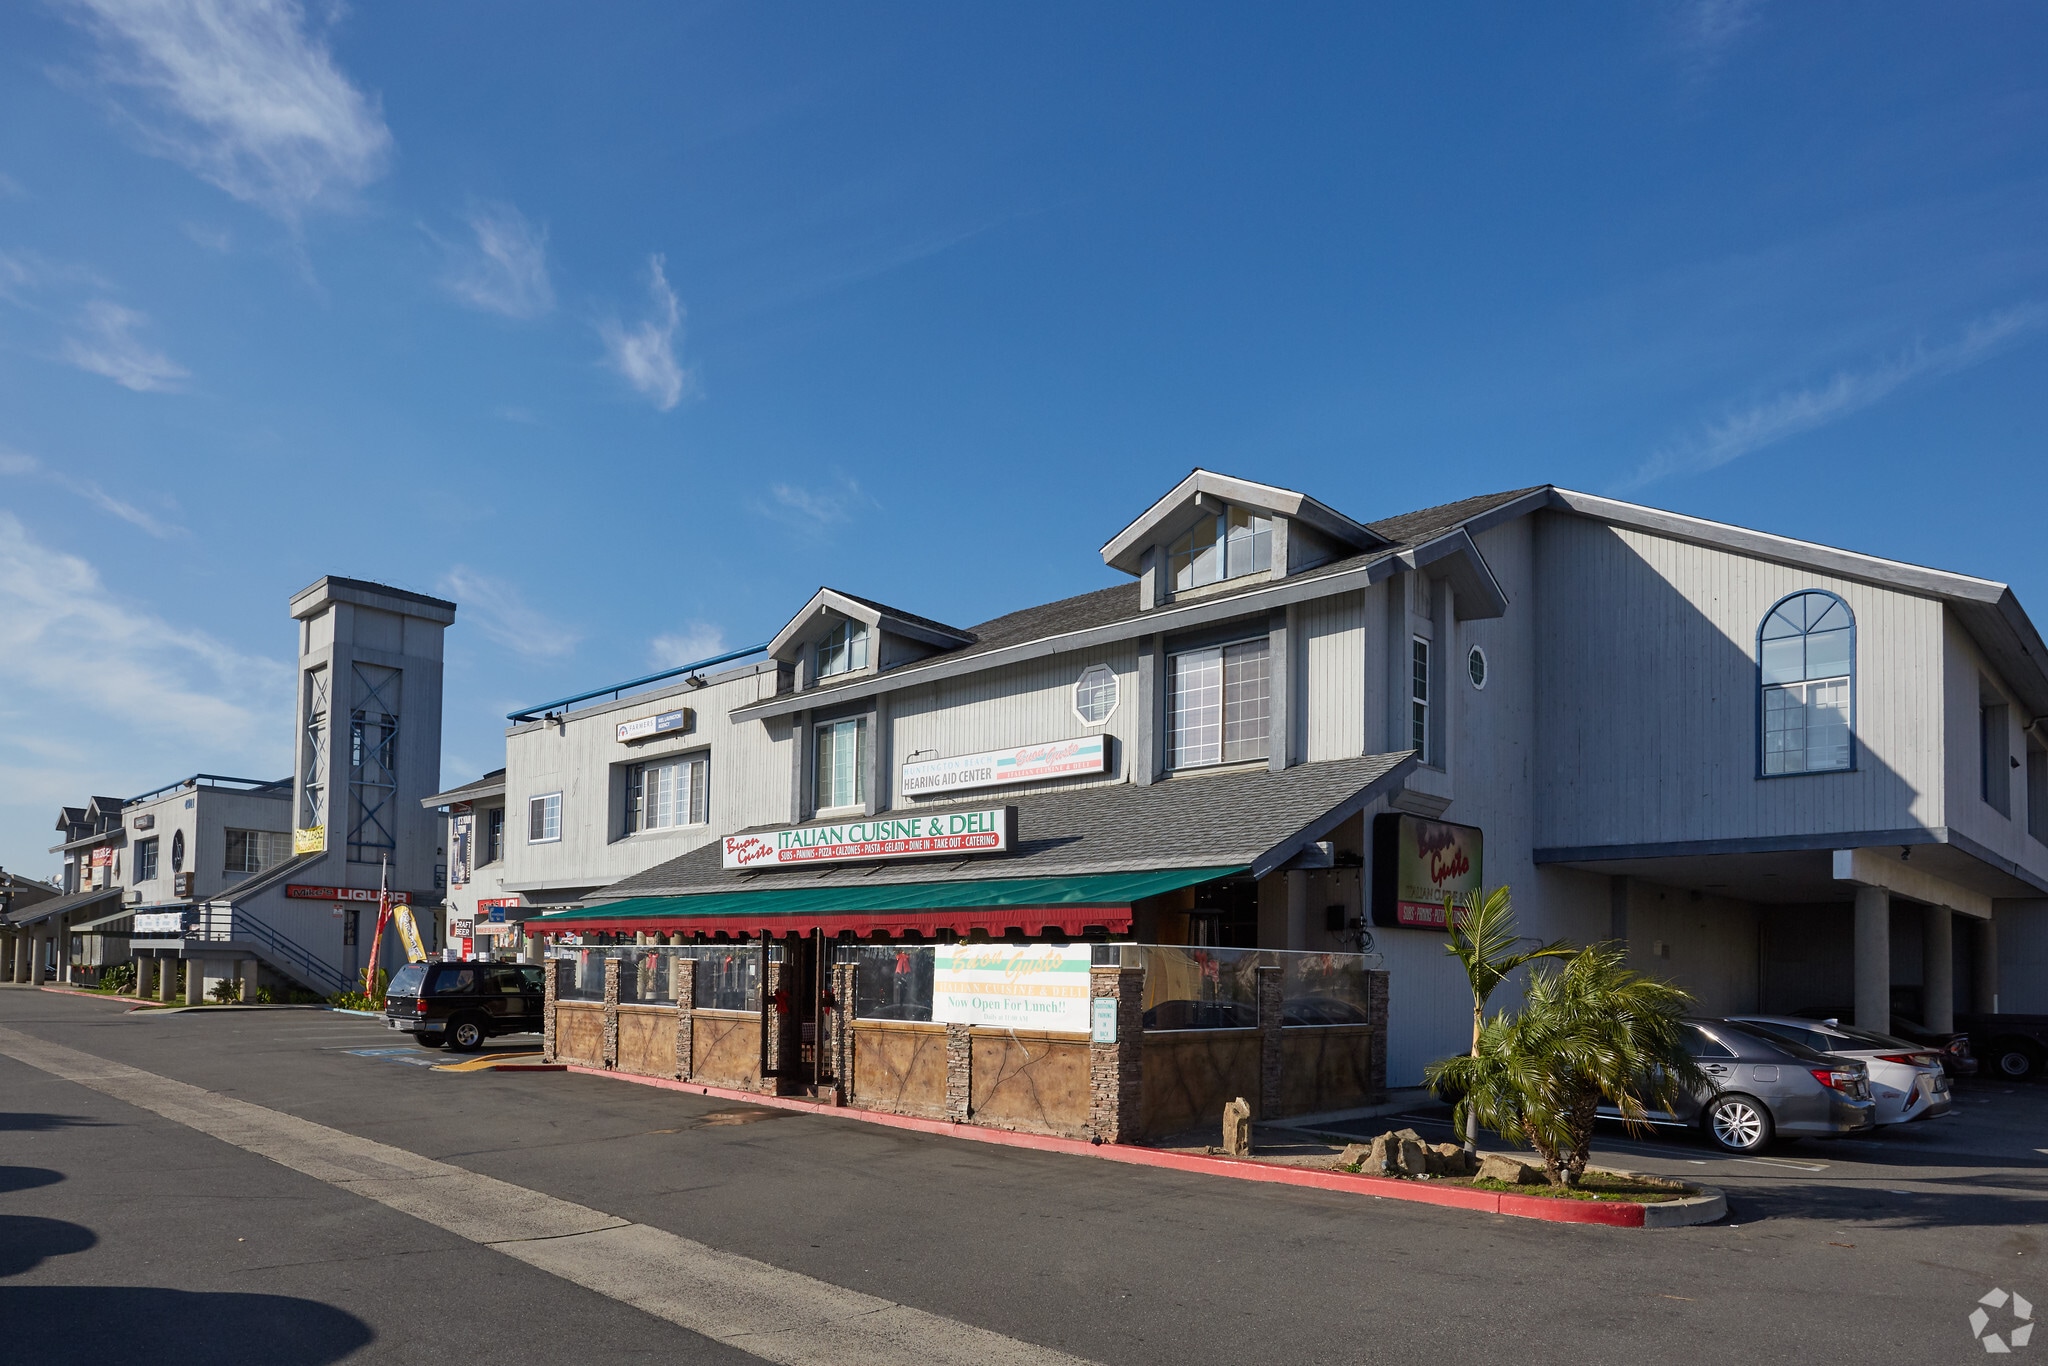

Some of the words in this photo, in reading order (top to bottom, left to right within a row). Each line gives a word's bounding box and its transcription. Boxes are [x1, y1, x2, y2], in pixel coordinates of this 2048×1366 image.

[629, 720, 654, 731] FARMERS
[1014, 746, 1045, 767] Buon
[1045, 742, 1080, 768] Gusto
[903, 761, 960, 776] HUNTINGTON
[964, 756, 993, 769] BEACH
[1007, 769, 1035, 778] ITALIAN
[1036, 764, 1064, 775] CUISINE
[1073, 761, 1091, 769] DELI
[903, 774, 940, 790] HEARING
[942, 771, 957, 785] AID
[959, 767, 992, 783] CENTER
[777, 826, 843, 849] ITALIAN
[848, 818, 921, 843] CUISINE
[928, 817, 944, 837] &
[949, 811, 995, 835] DELI
[725, 837, 760, 854] Buon
[780, 850, 793, 860] SUBS
[796, 848, 815, 859] PANINIS
[818, 847, 832, 857] PIZZA
[835, 844, 861, 856] CALZONES
[864, 844, 881, 854] PASTA
[884, 841, 905, 853] GELATO
[909, 840, 923, 851] DINE
[923, 839, 930, 850] IN
[934, 838, 949, 849] TAKE
[949, 837, 962, 848] OUT
[965, 834, 995, 847] CATERING
[737, 844, 774, 865] Gusto
[1431, 848, 1469, 888] Gusto
[292, 888, 334, 897] Mike's
[1403, 905, 1415, 921] SUBS
[455, 921, 472, 929] CRAFT
[455, 928, 470, 936] BEER
[952, 947, 1003, 974] Buon
[1005, 949, 1063, 985] Gusto
[940, 981, 981, 993] ITALIAN
[985, 982, 1034, 996] CUISINE
[1039, 987, 1047, 996] &
[1052, 987, 1083, 997] DELI
[948, 996, 968, 1007] Now
[971, 996, 1001, 1012] Open
[1004, 999, 1022, 1011] For
[1024, 1000, 1066, 1014] Lunch!!
[983, 1013, 997, 1022] Daily
[1018, 1015, 1029, 1023] AM
